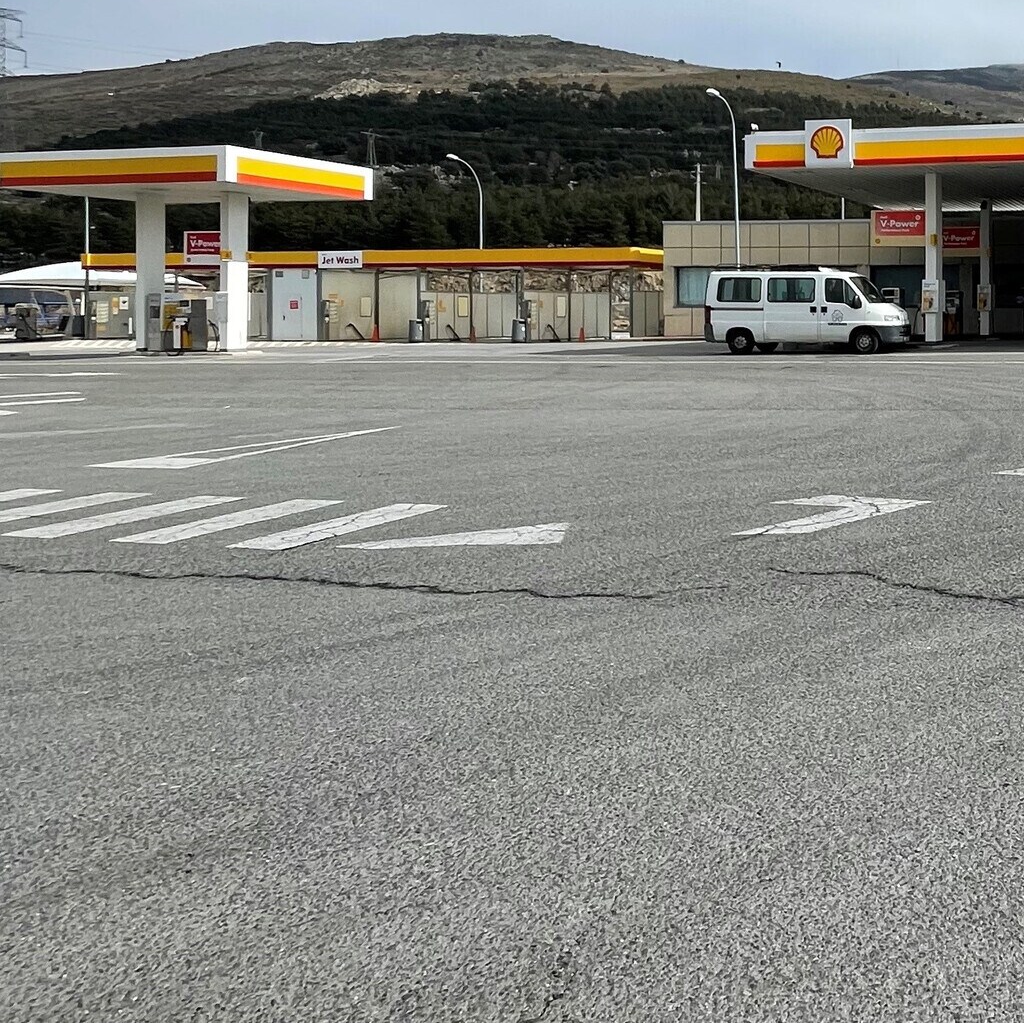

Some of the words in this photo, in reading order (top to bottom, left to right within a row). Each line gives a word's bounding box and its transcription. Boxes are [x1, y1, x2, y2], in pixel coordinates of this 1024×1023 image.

[880, 219, 919, 228] V-Power
[322, 256, 334, 265] Jet
[336, 255, 359, 264] Wash
